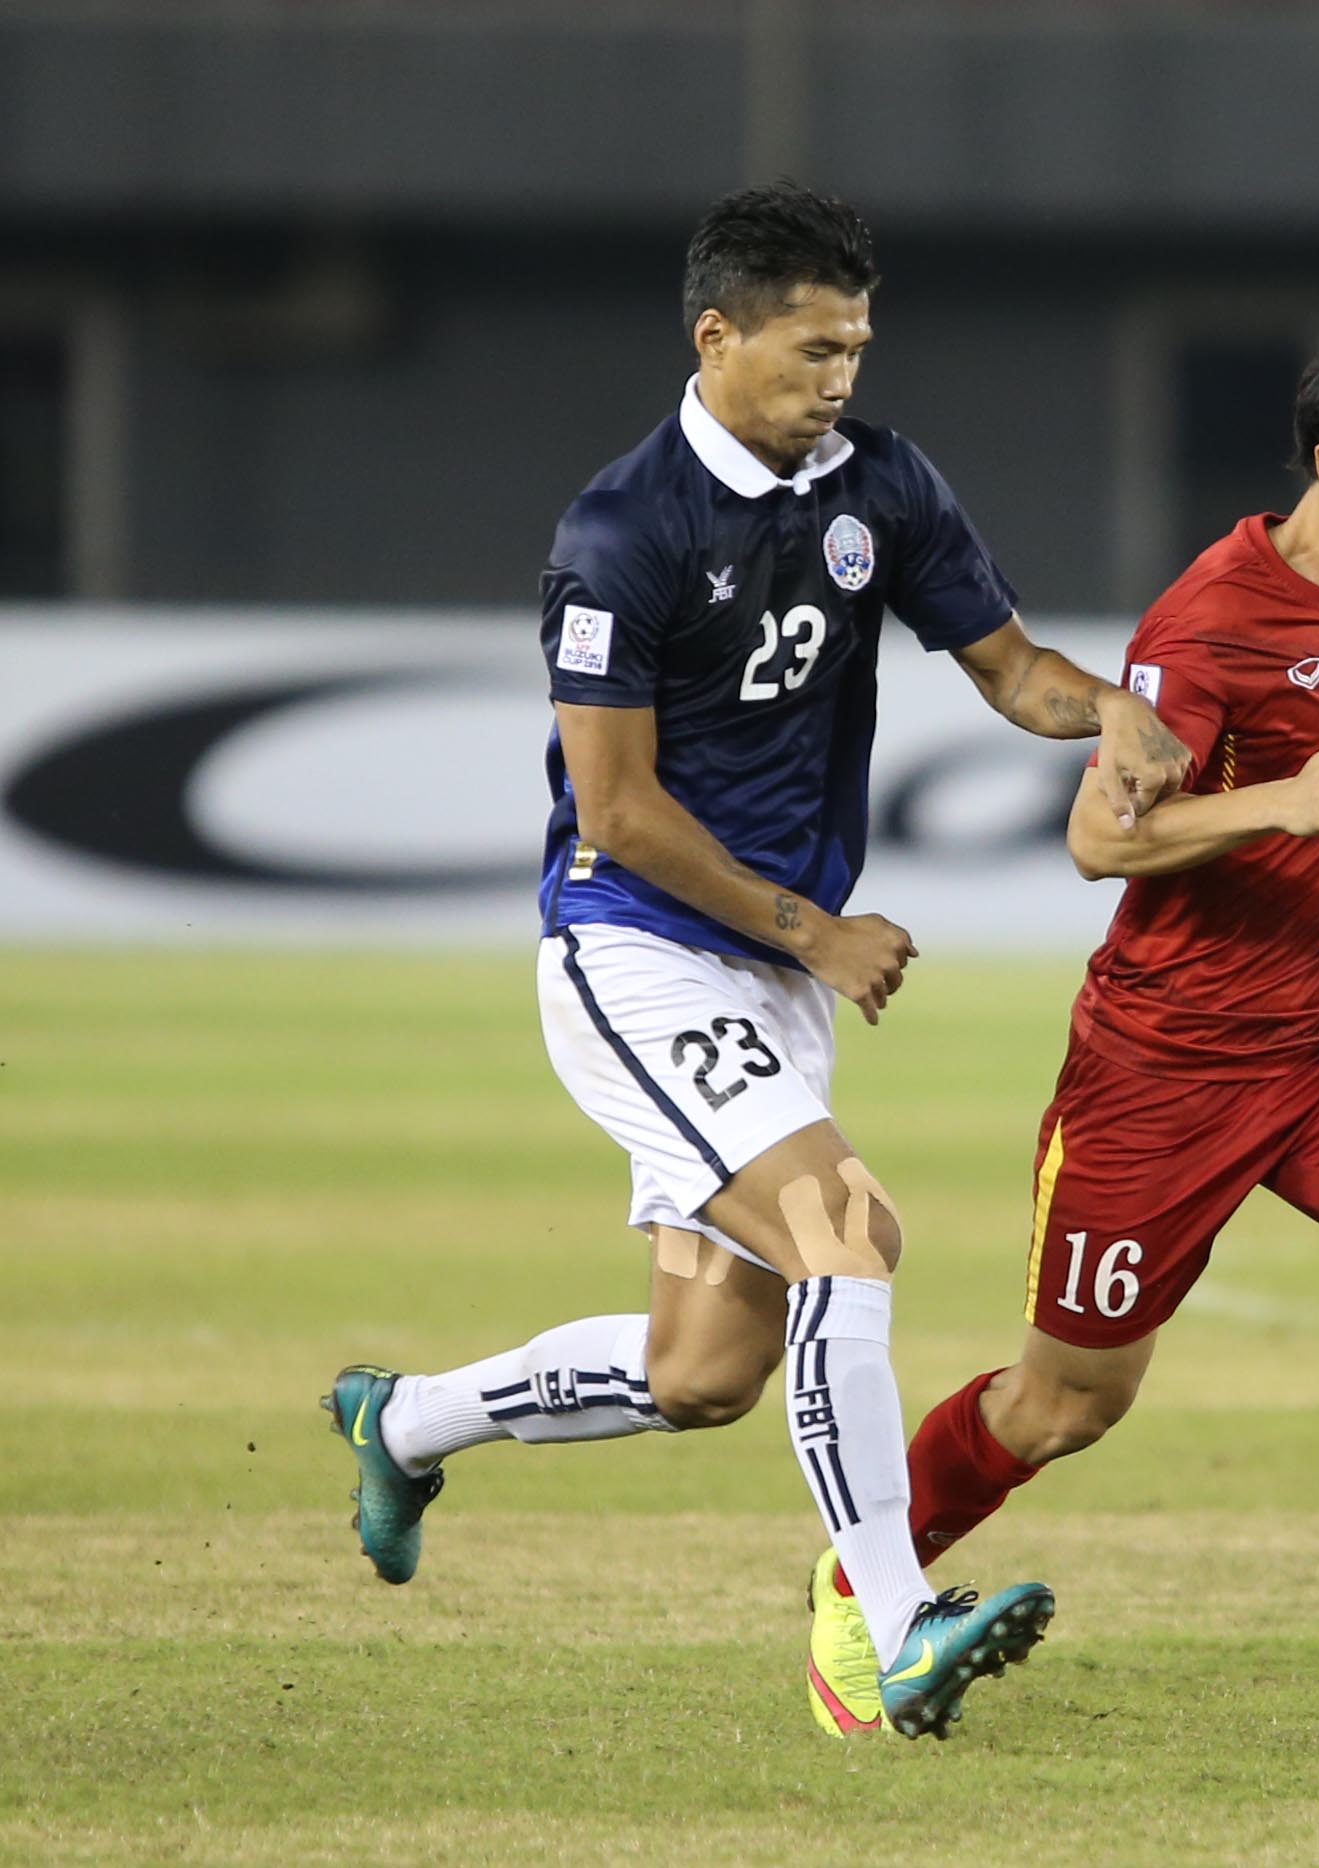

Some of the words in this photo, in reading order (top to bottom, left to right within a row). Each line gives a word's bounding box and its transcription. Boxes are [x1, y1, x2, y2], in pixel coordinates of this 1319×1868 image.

[708, 584, 736, 604] FBT
[562, 655, 583, 665] CUP
[565, 648, 604, 662] SUZUKI
[740, 604, 827, 701] 23
[670, 1017, 782, 1112] 23
[1056, 1230, 1144, 1319] 16
[794, 1386, 839, 1443] FBT
